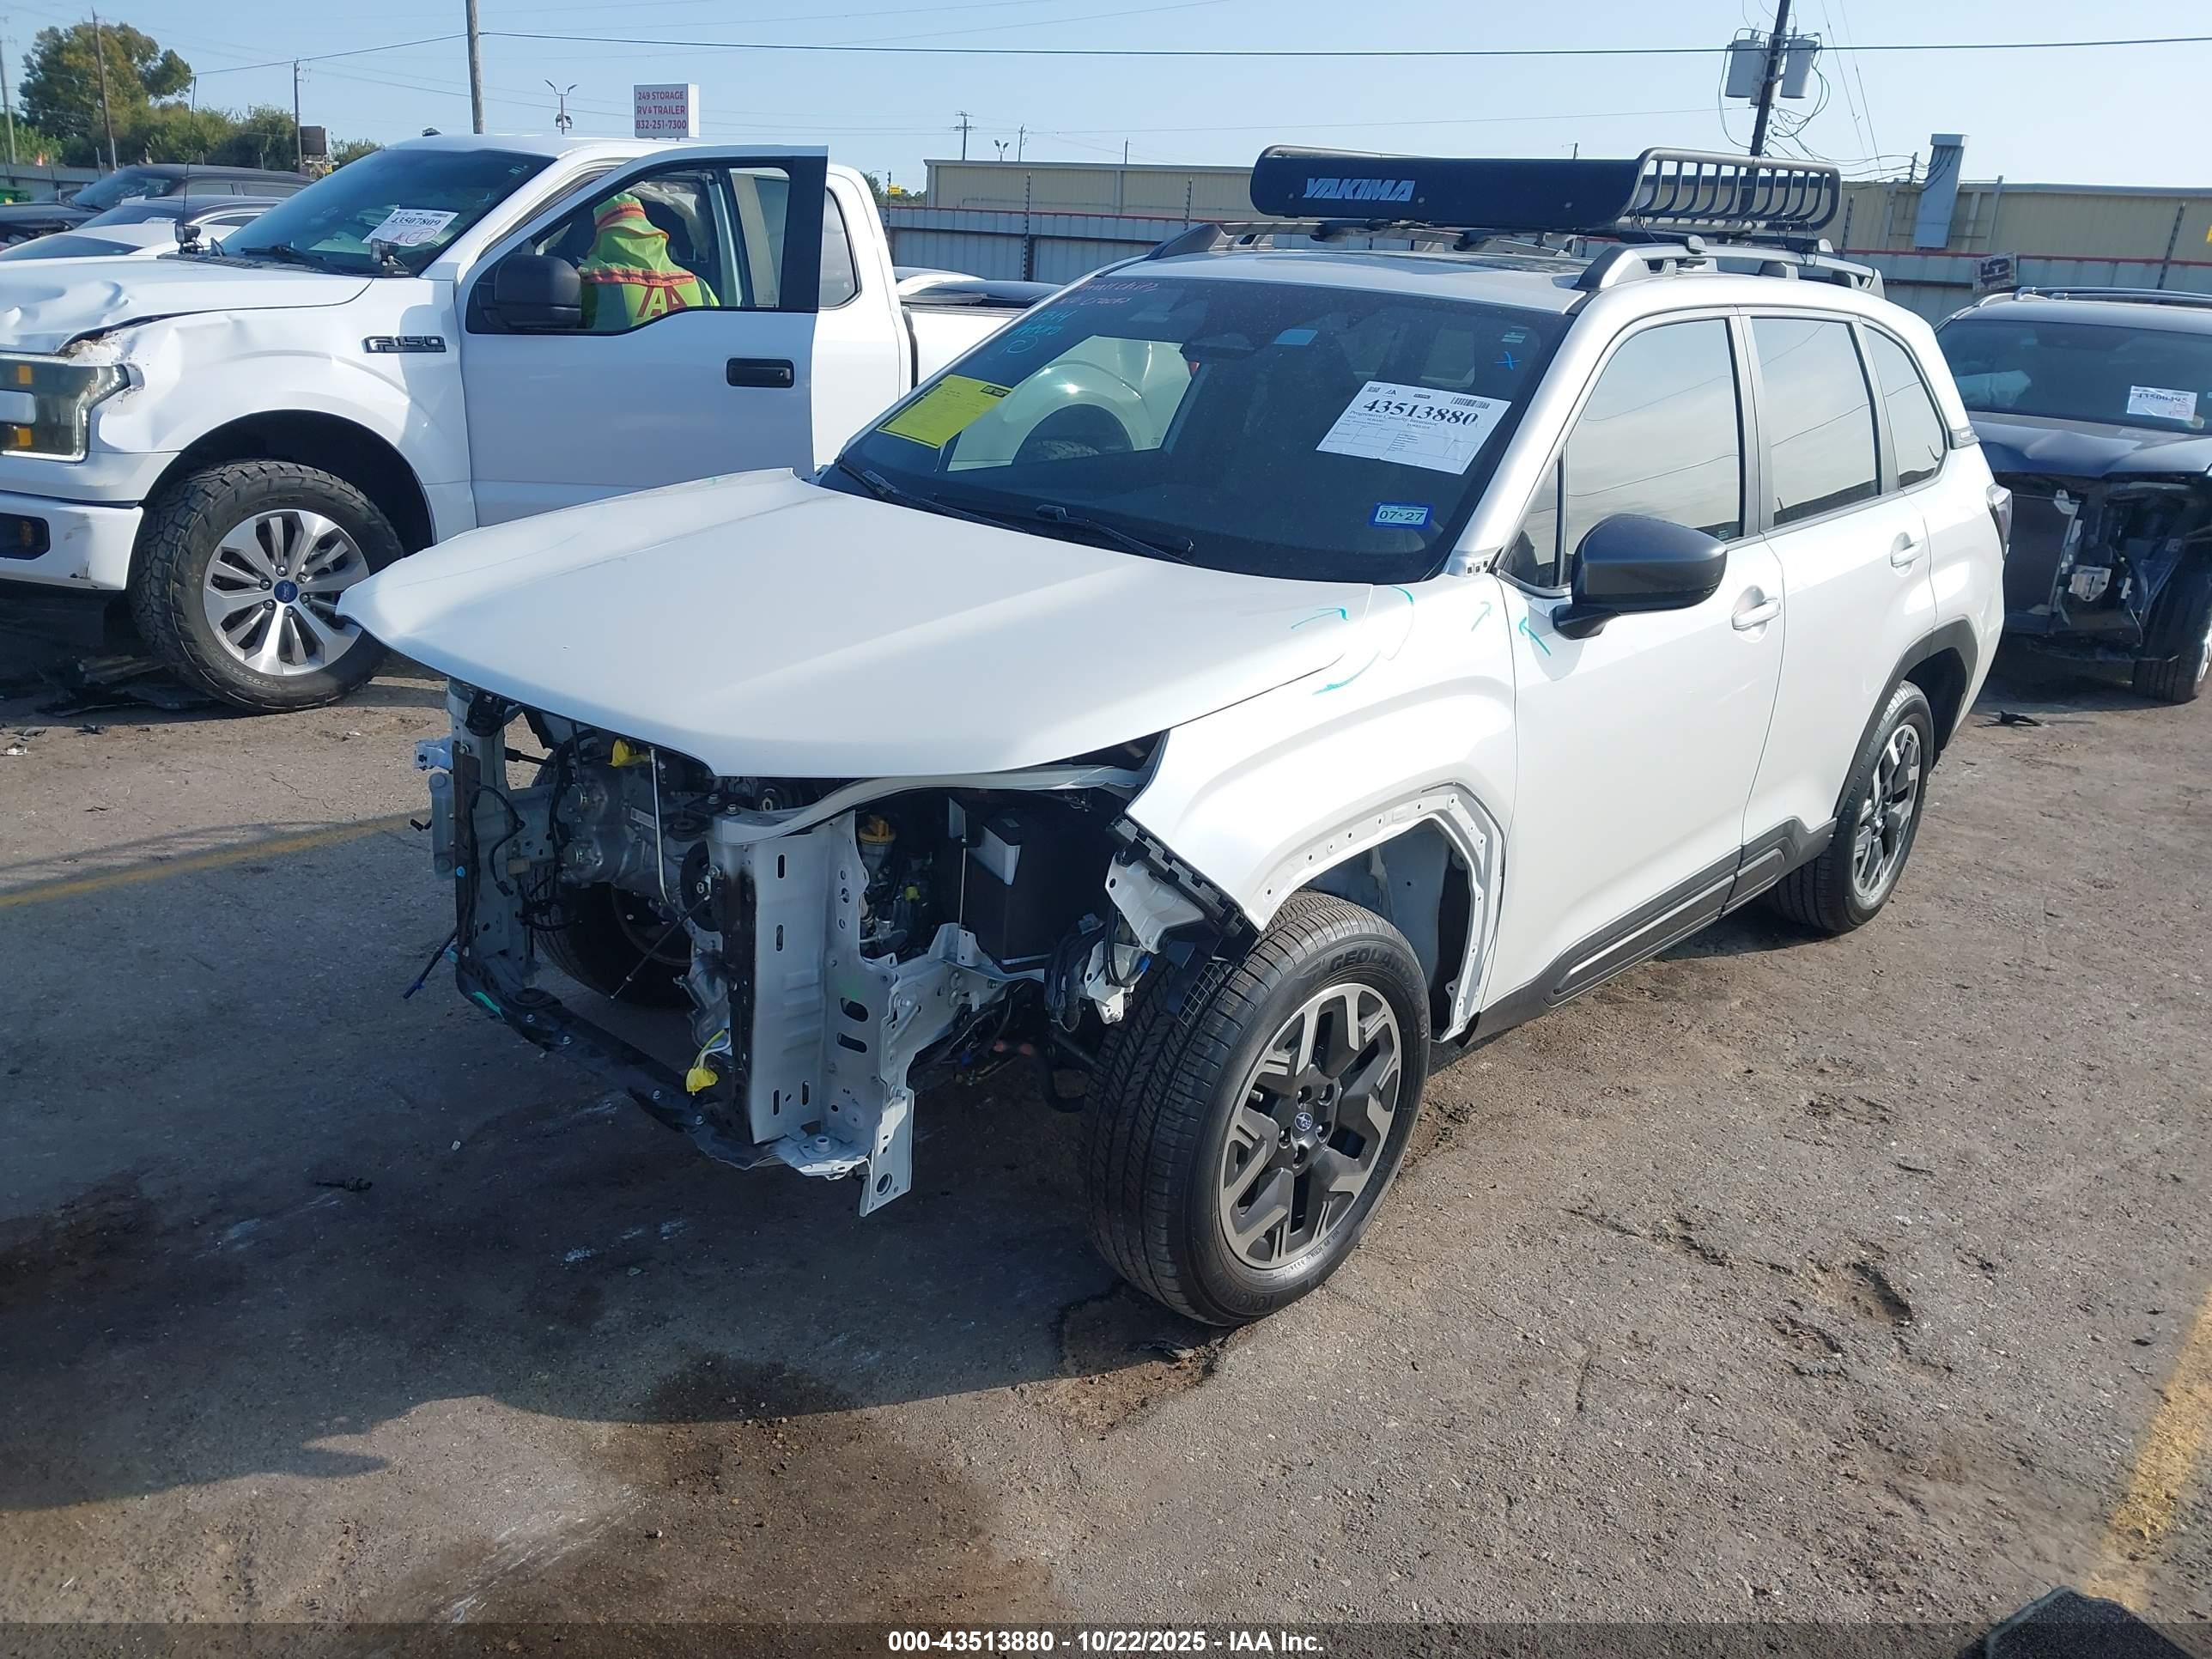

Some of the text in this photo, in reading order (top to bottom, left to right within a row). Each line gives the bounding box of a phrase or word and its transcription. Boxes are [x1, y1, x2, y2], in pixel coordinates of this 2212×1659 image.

[638, 90, 684, 100] 249 STORAGE
[653, 105, 686, 115] TRAILER
[635, 119, 687, 130] 832-251-7300
[1302, 178, 1416, 202] YAKIMA
[1362, 398, 1480, 428] 43513880
